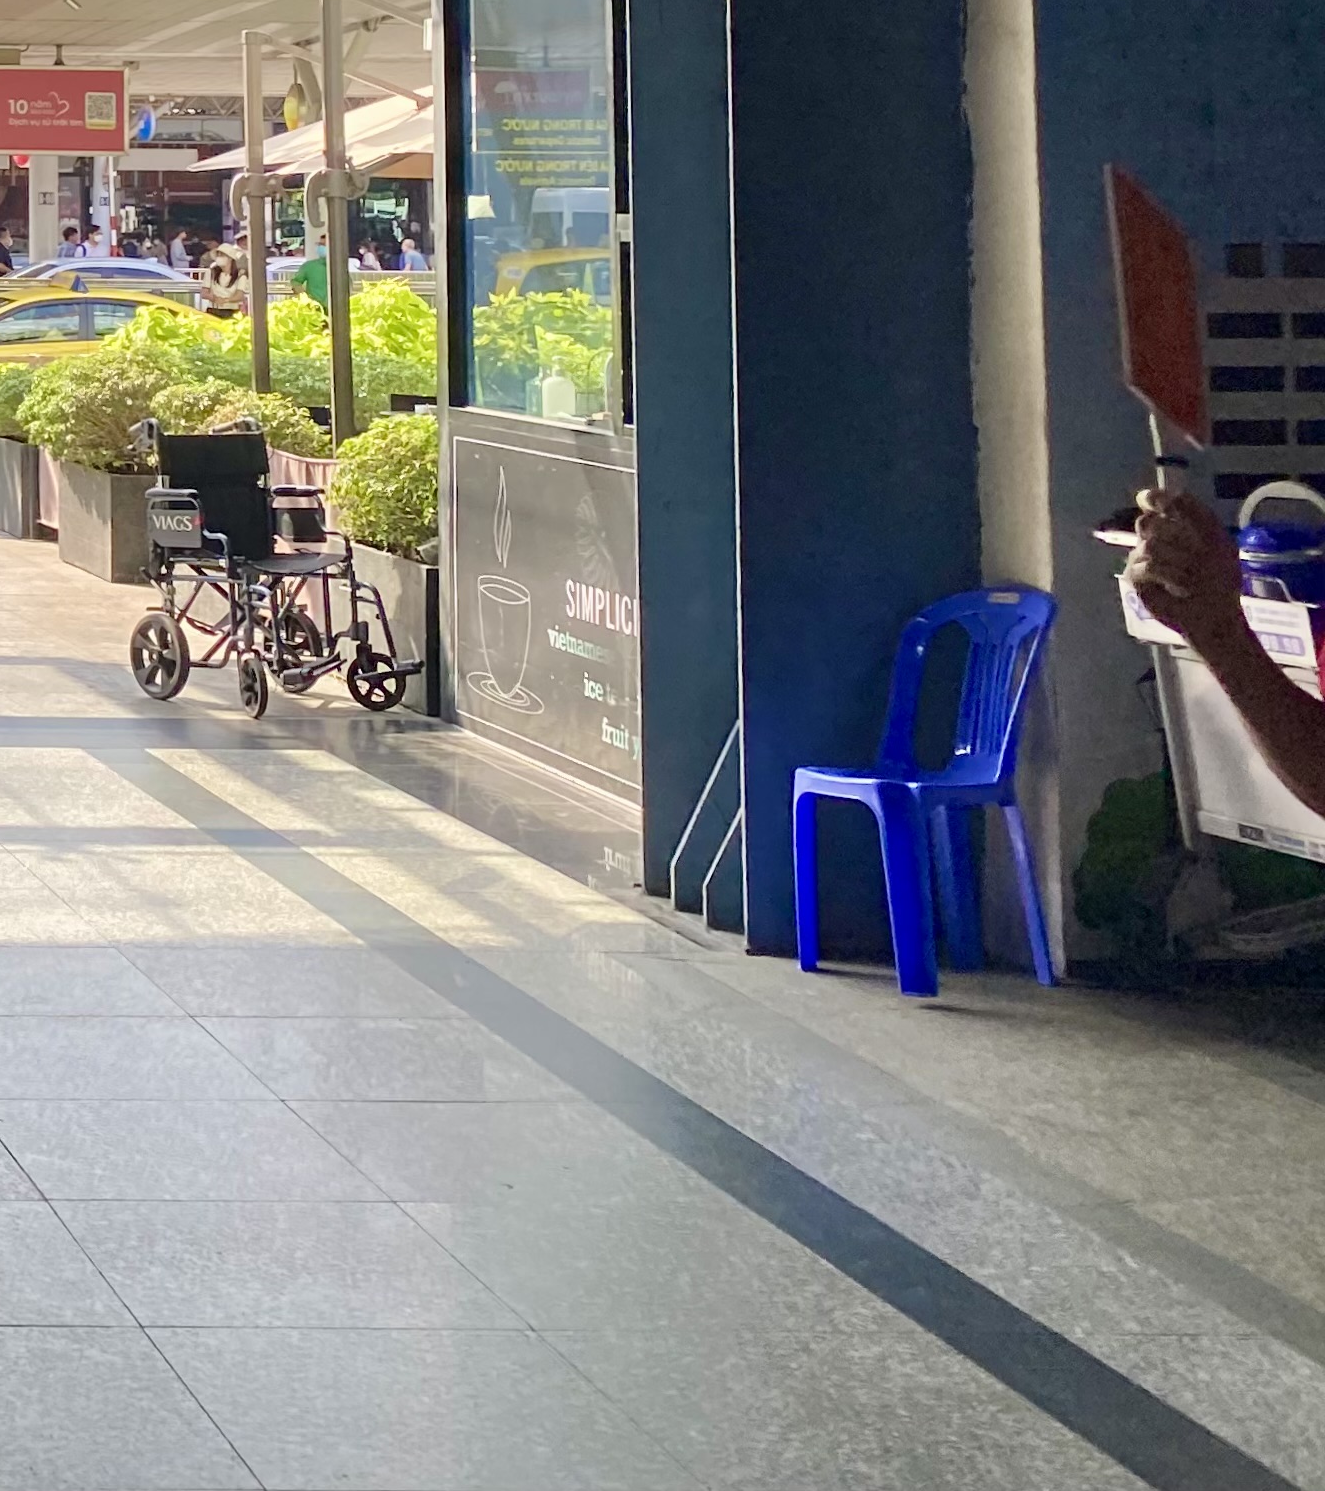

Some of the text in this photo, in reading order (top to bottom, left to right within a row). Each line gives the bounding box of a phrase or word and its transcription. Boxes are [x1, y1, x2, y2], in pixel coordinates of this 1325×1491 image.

[8, 99, 28, 115] 10
[152, 513, 193, 531] VIAGS
[583, 671, 603, 702] ice
[601, 716, 630, 752] fruit
